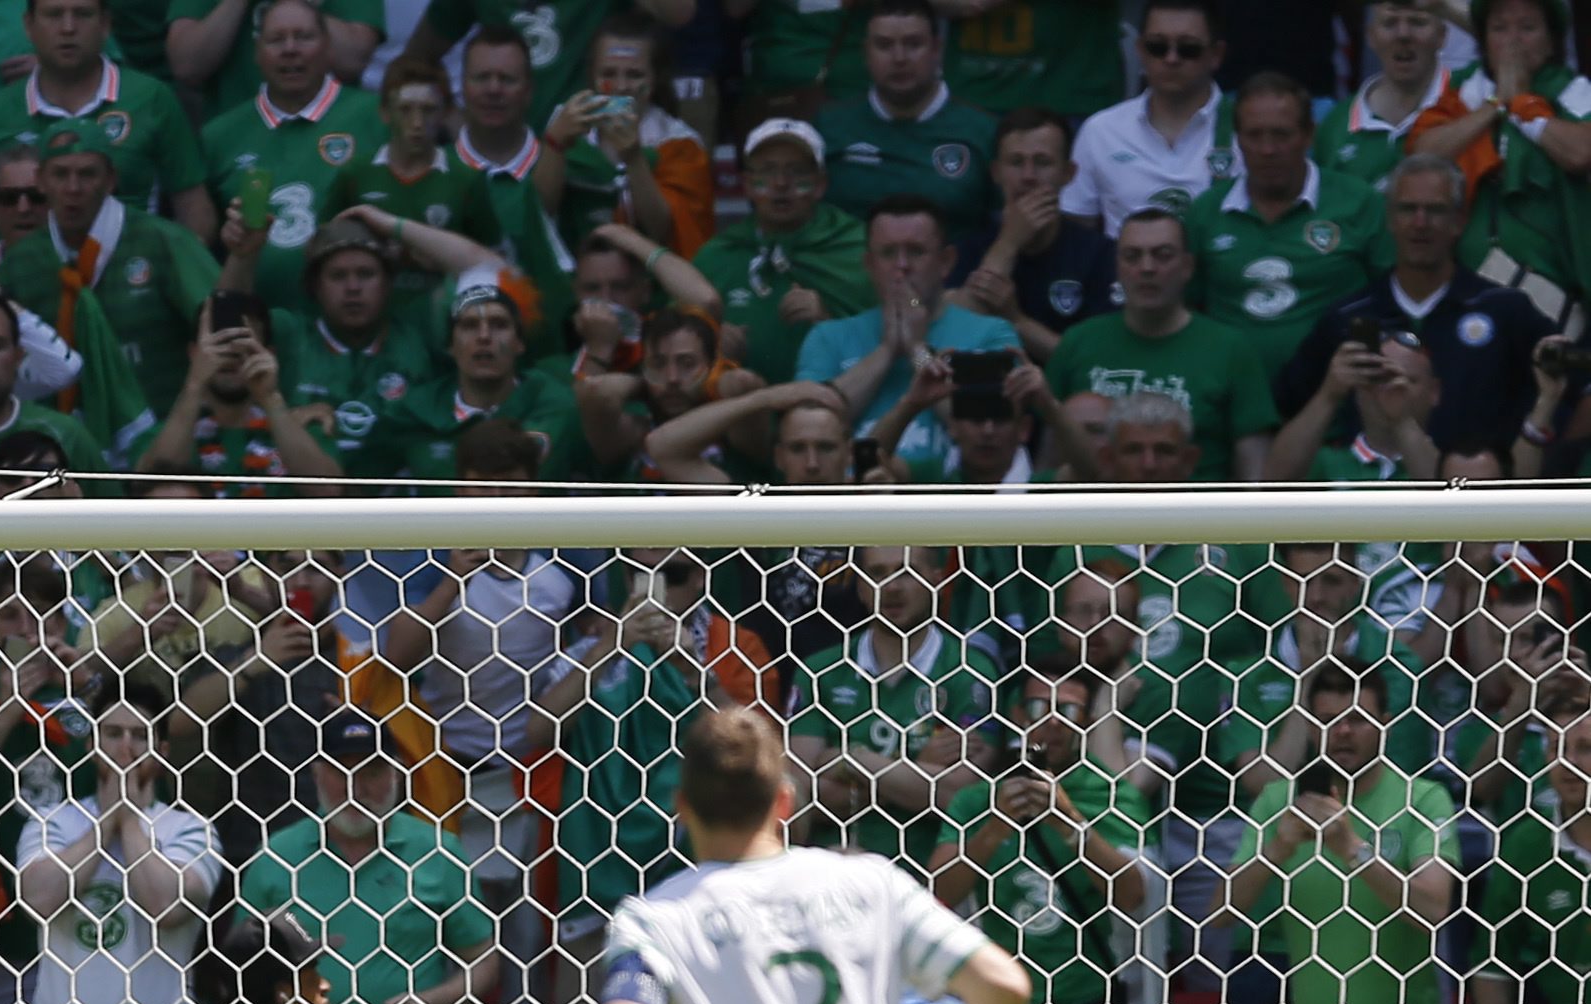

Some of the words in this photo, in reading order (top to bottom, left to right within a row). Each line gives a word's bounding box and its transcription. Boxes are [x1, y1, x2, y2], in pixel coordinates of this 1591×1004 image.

[268, 182, 316, 249] 3
[1242, 256, 1299, 320] 3
[1134, 595, 1182, 660] 3
[1014, 870, 1064, 934] 3
